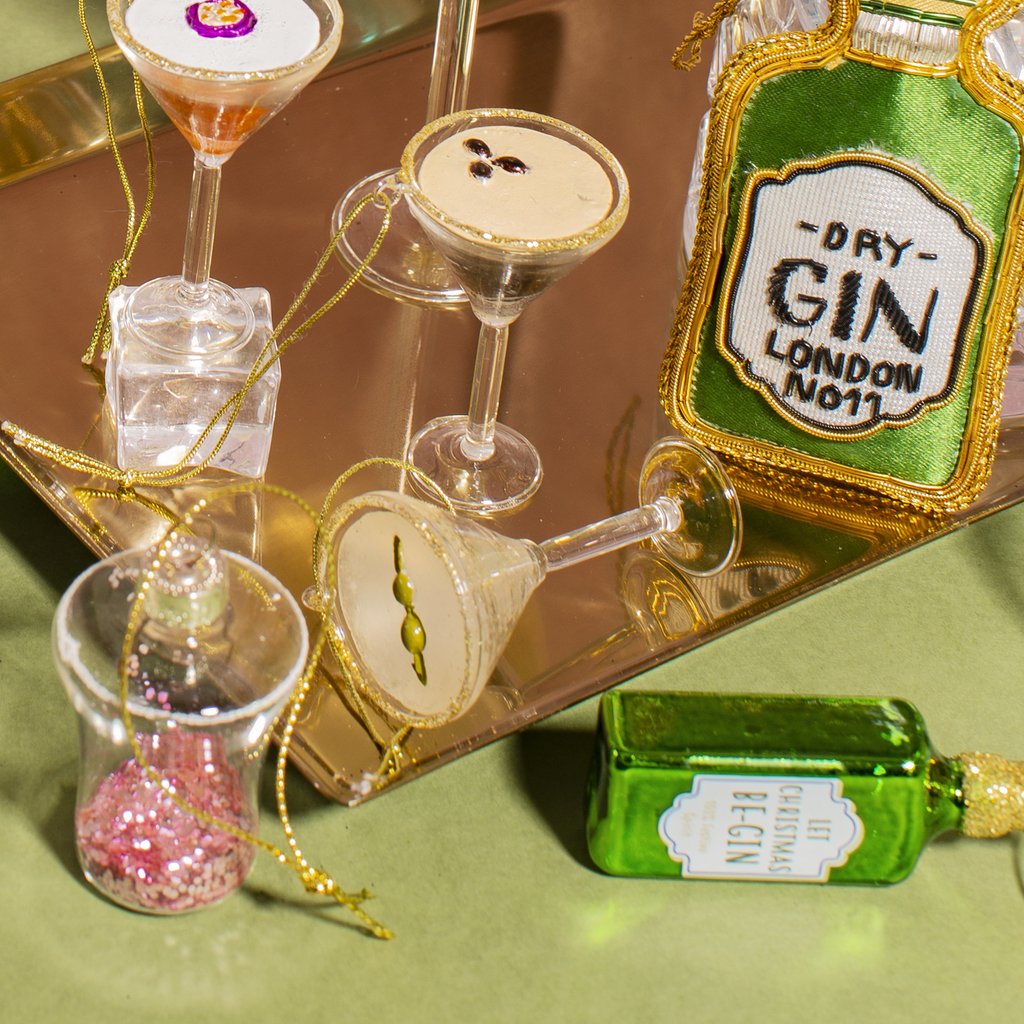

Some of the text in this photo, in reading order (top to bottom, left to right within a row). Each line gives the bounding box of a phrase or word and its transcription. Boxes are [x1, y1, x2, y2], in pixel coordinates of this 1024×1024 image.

[768, 258, 939, 354] GIN
[765, 329, 924, 393] LONDON
[725, 790, 768, 864] BE-GIN
[768, 784, 803, 873] CHRISTMAS
[807, 819, 832, 842] LET
